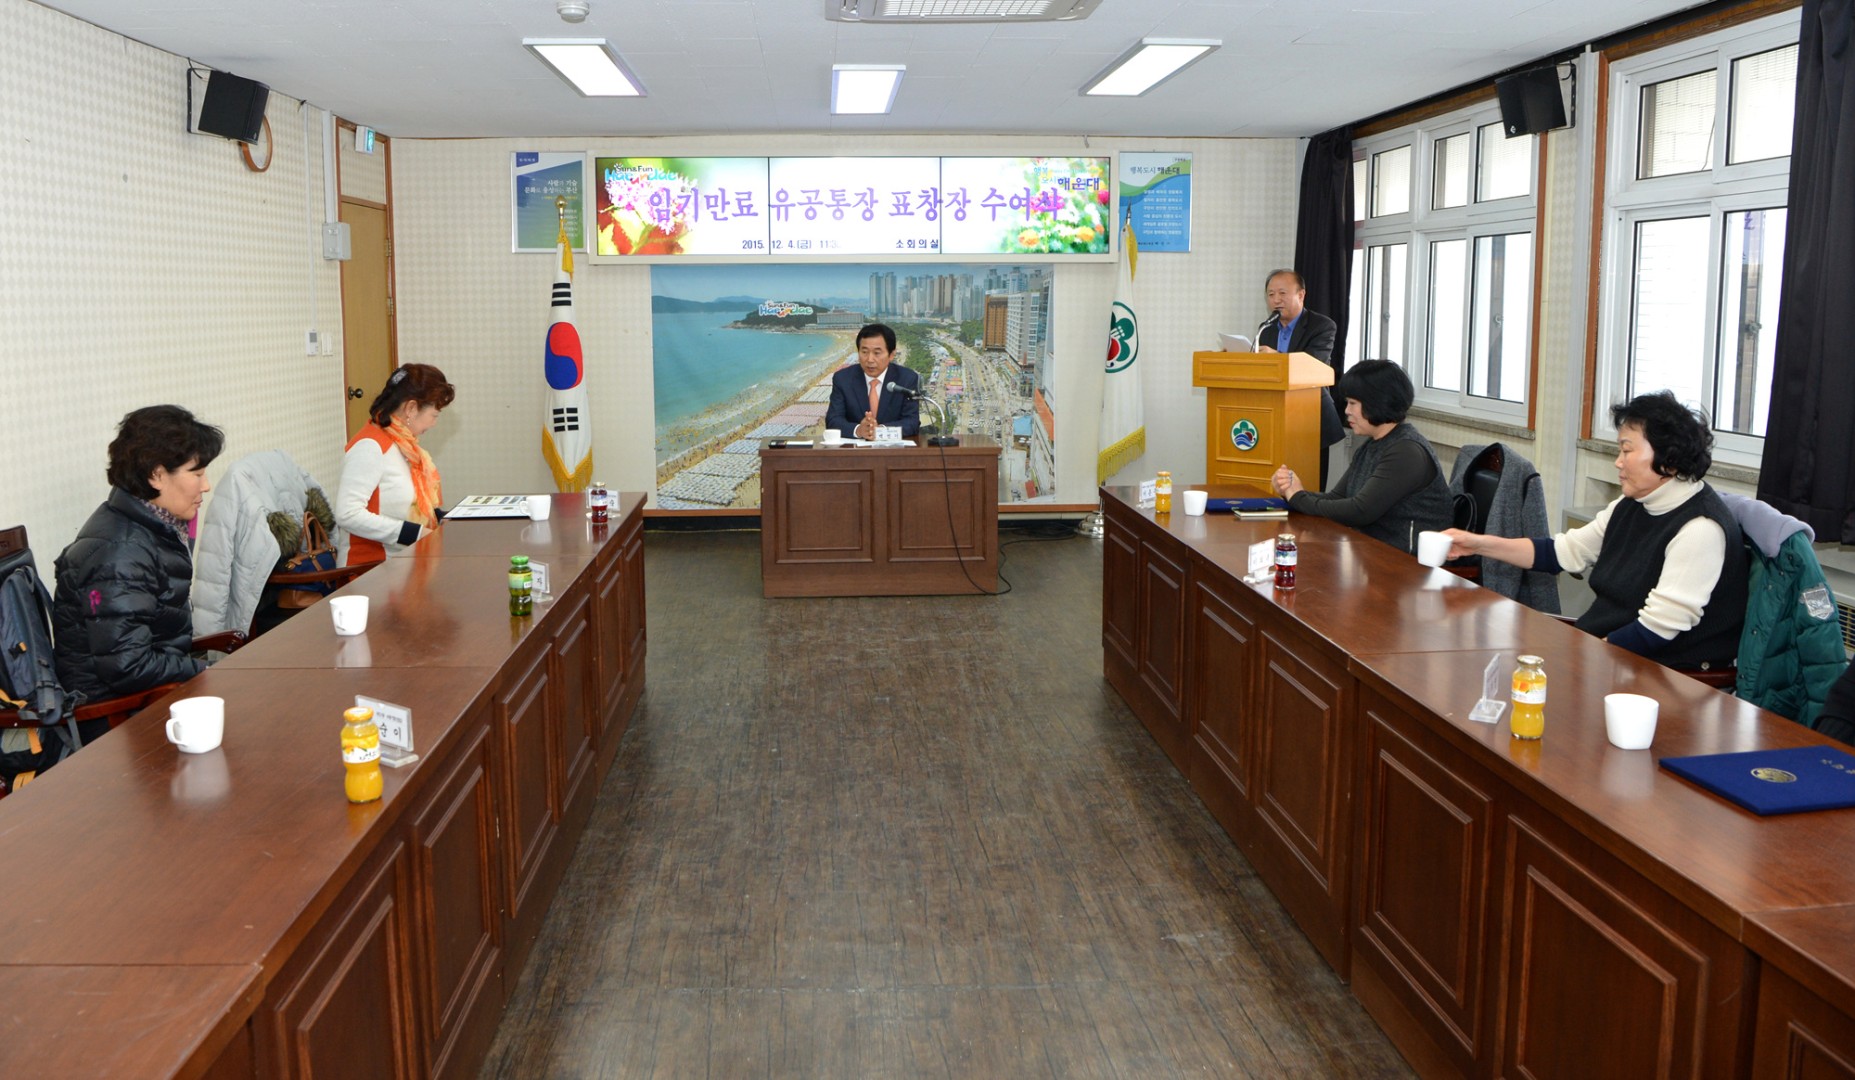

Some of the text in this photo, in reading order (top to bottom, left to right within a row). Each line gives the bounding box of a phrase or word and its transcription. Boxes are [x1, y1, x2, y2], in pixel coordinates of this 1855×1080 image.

[615, 165, 653, 173] Sun&Fun
[1157, 167, 1180, 175] 해운대
[1057, 177, 1100, 191] 해운대
[649, 187, 1058, 223] 임기만료 유공통장 표창장 수여식
[742, 239, 765, 249] 2015.
[772, 239, 784, 249] 12.
